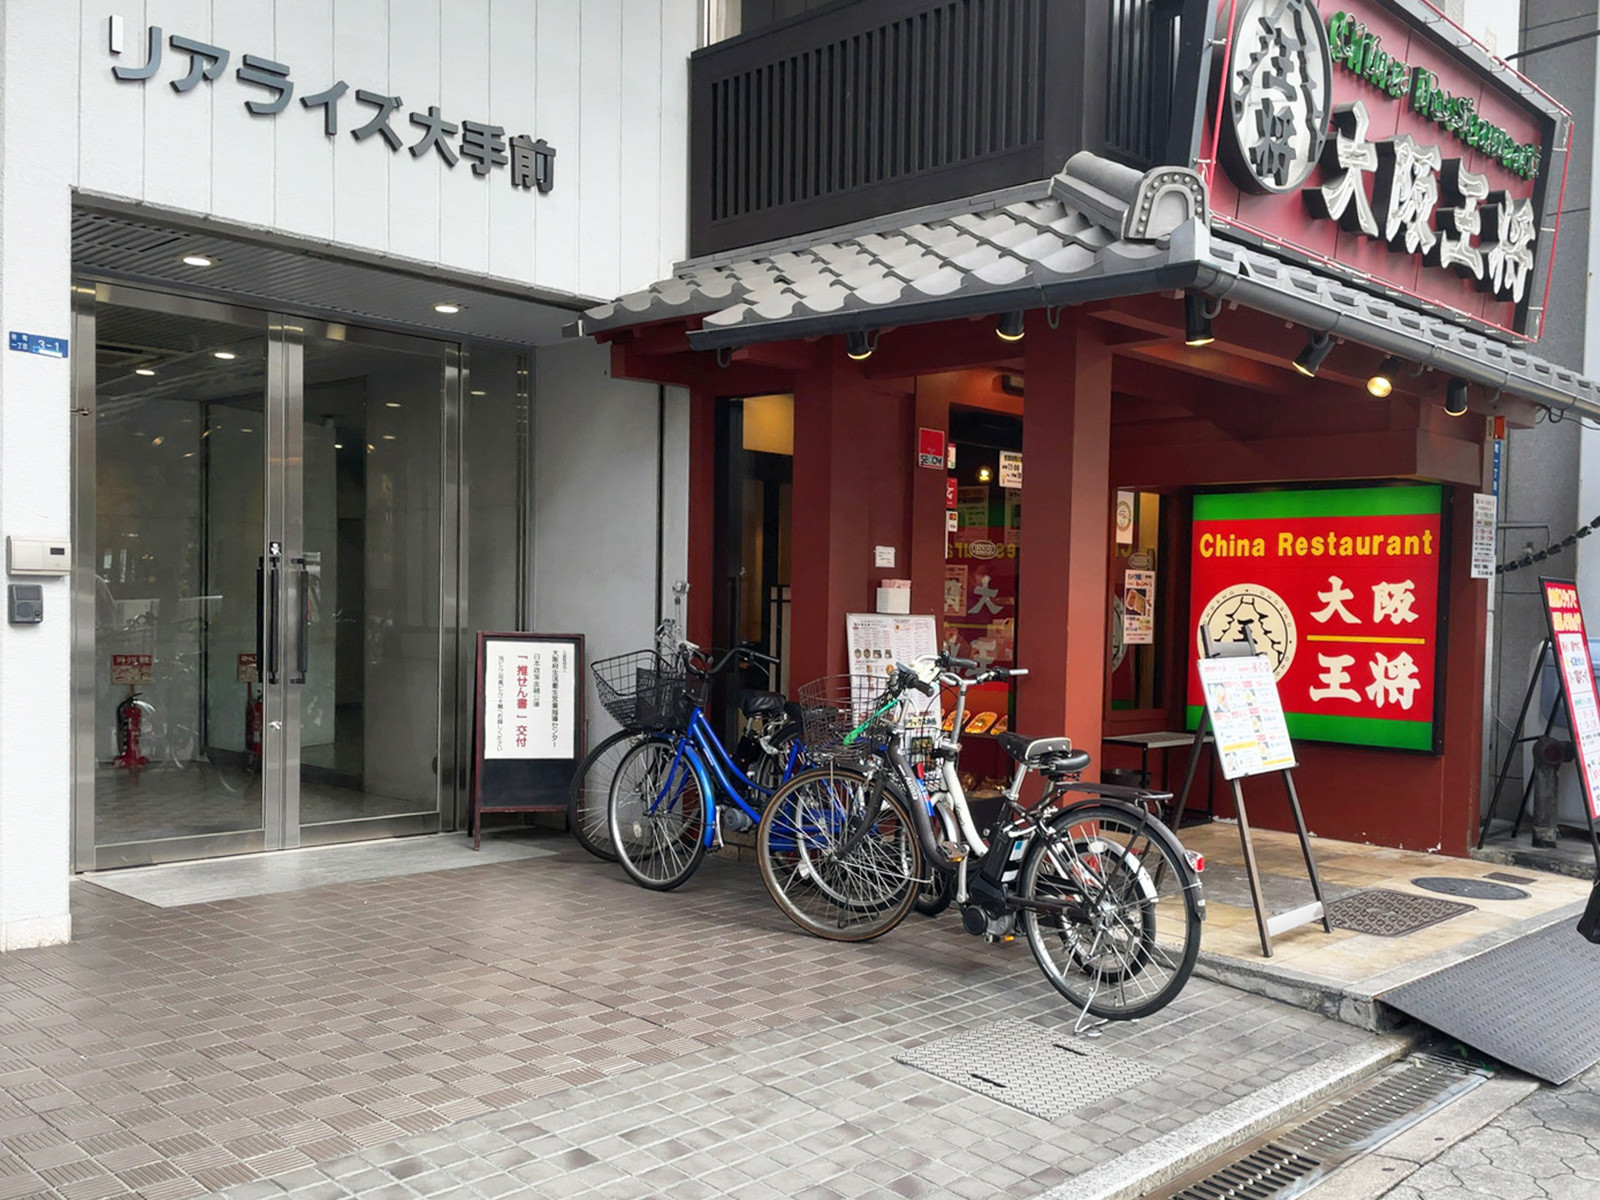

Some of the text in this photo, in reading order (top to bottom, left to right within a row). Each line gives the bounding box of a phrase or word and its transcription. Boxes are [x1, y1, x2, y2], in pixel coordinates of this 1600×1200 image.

[109, 14, 557, 194] リアライズ大手前
[1312, 100, 1537, 303] 大阪王将
[1200, 529, 1433, 558] China Restaurant
[1310, 575, 1419, 625] 大阪
[1309, 652, 1421, 710] 王将
